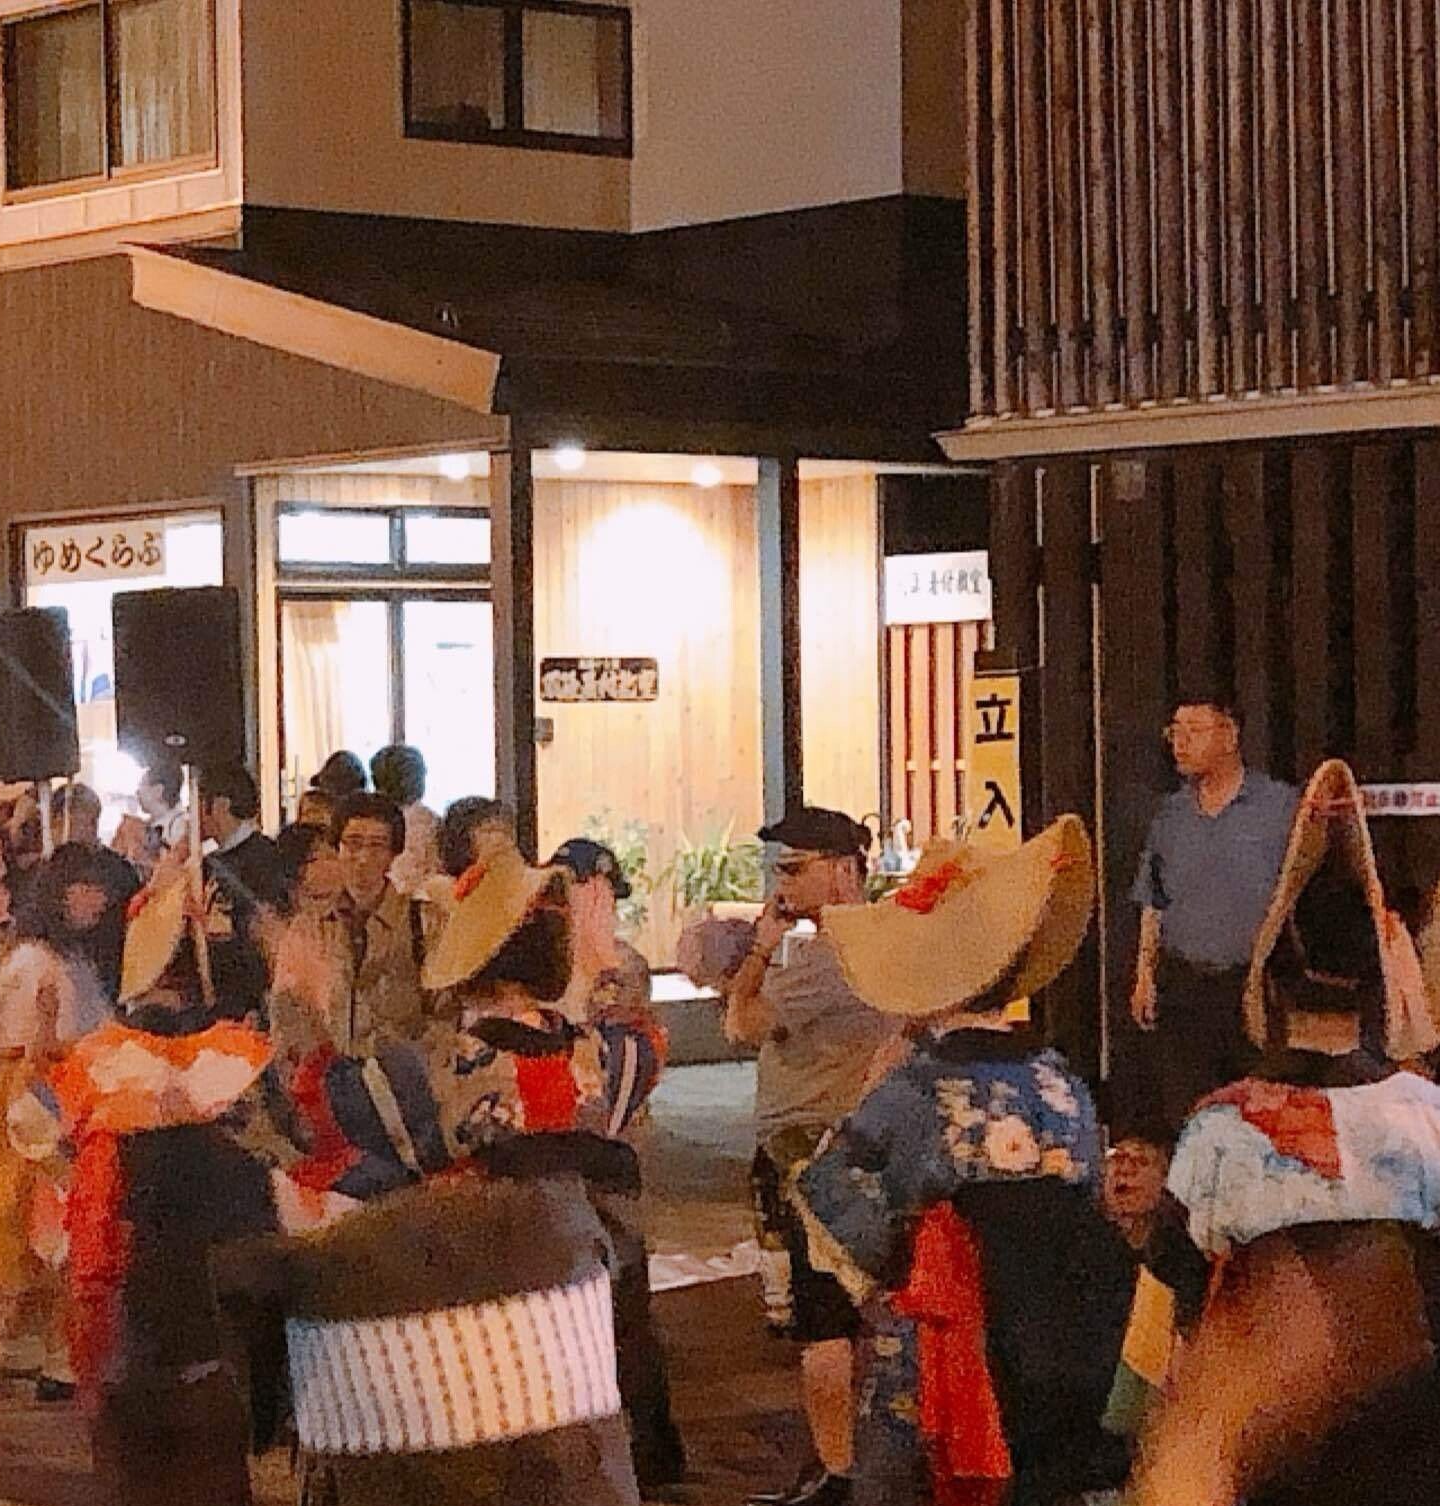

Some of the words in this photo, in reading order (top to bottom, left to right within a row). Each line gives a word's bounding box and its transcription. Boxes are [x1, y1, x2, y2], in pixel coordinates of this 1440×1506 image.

[33, 531, 163, 576] ゆめくらぶ
[975, 693, 1016, 830] 立入
